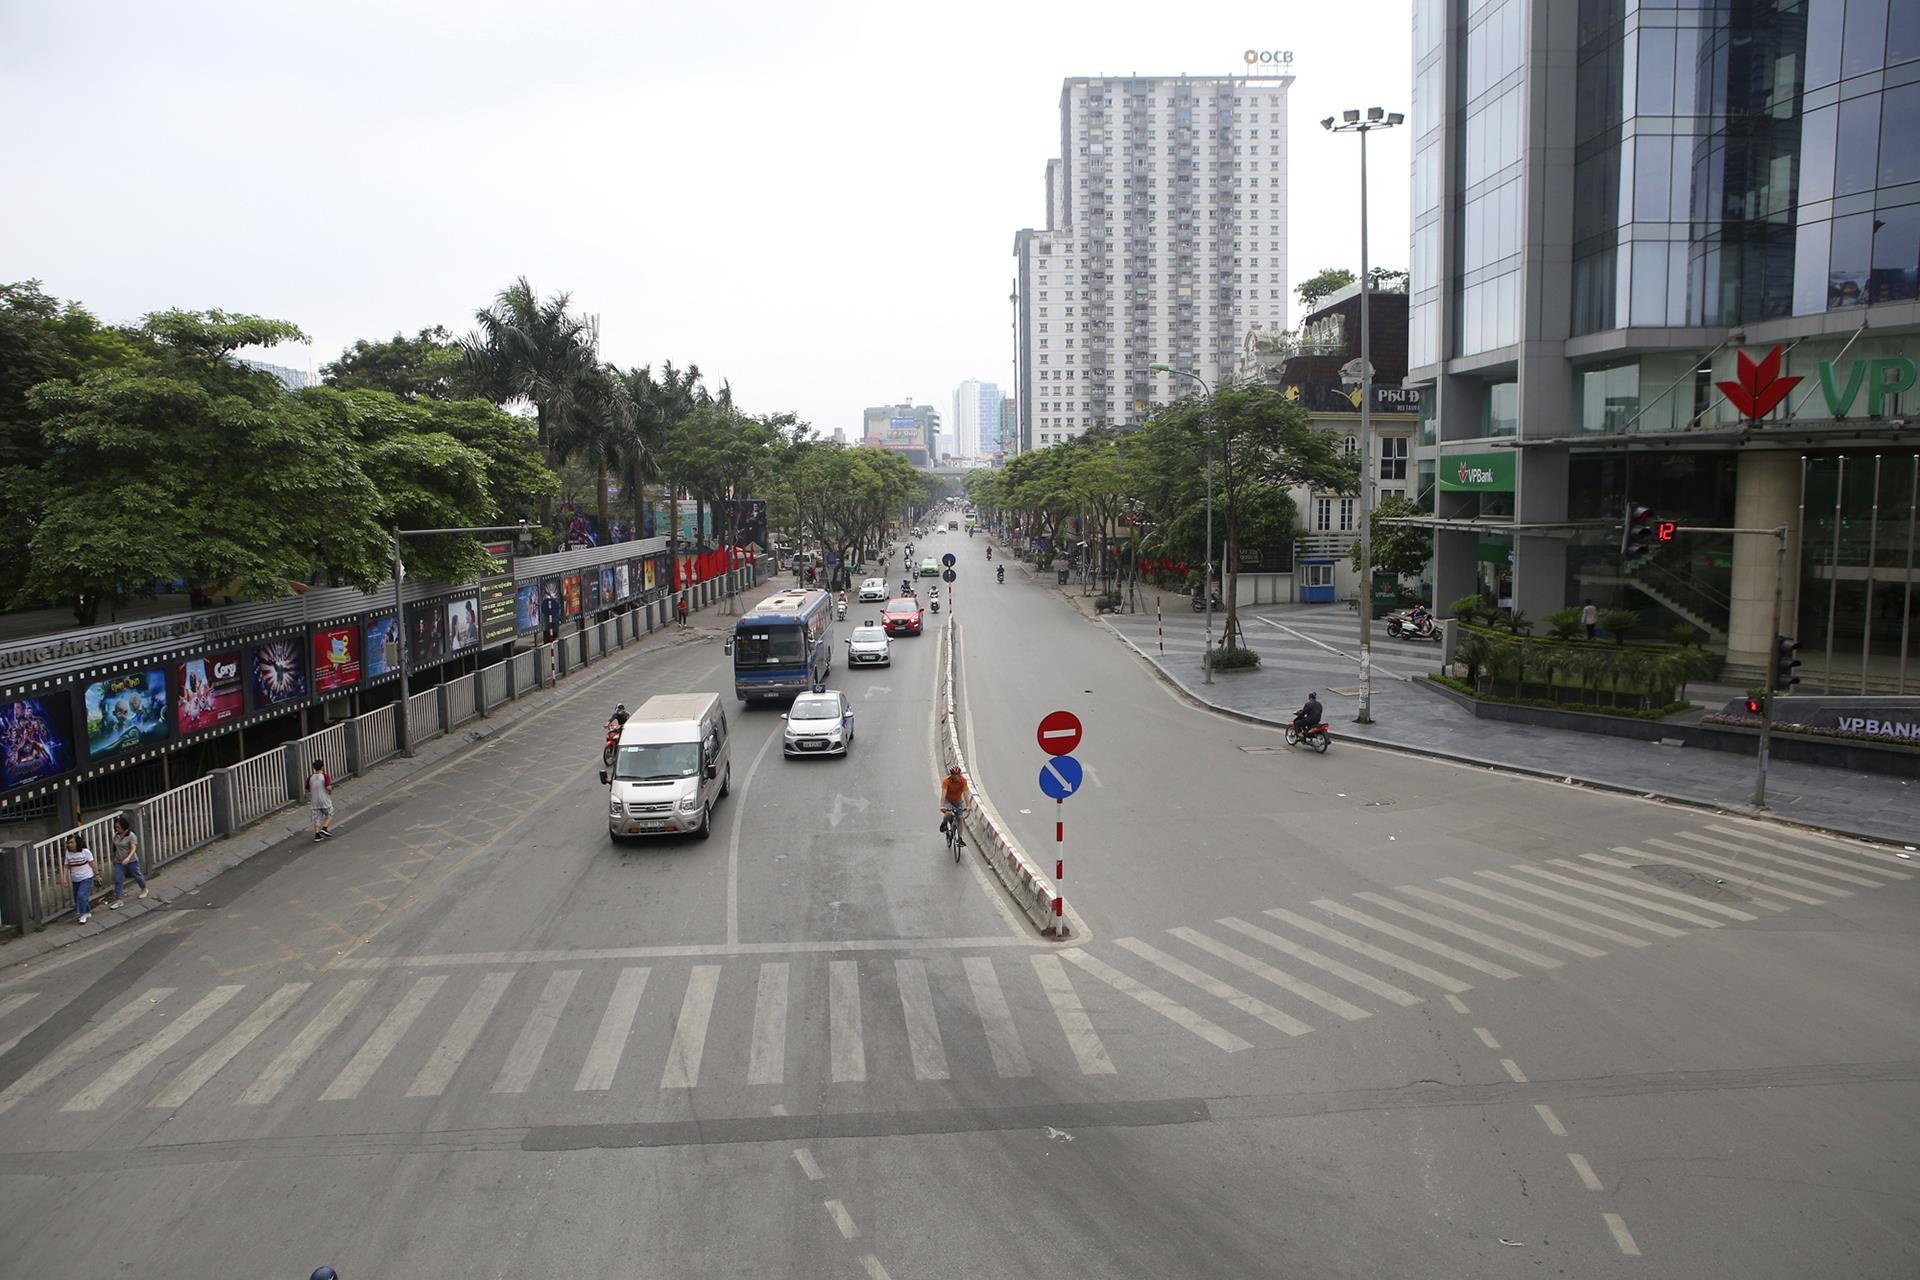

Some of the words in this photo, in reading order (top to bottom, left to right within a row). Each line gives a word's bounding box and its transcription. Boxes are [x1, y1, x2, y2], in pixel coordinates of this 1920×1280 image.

[1260, 51, 1293, 63] OCB
[1819, 357, 1917, 418] VP
[1468, 468, 1494, 483] VPBank
[1659, 523, 1675, 541] 12
